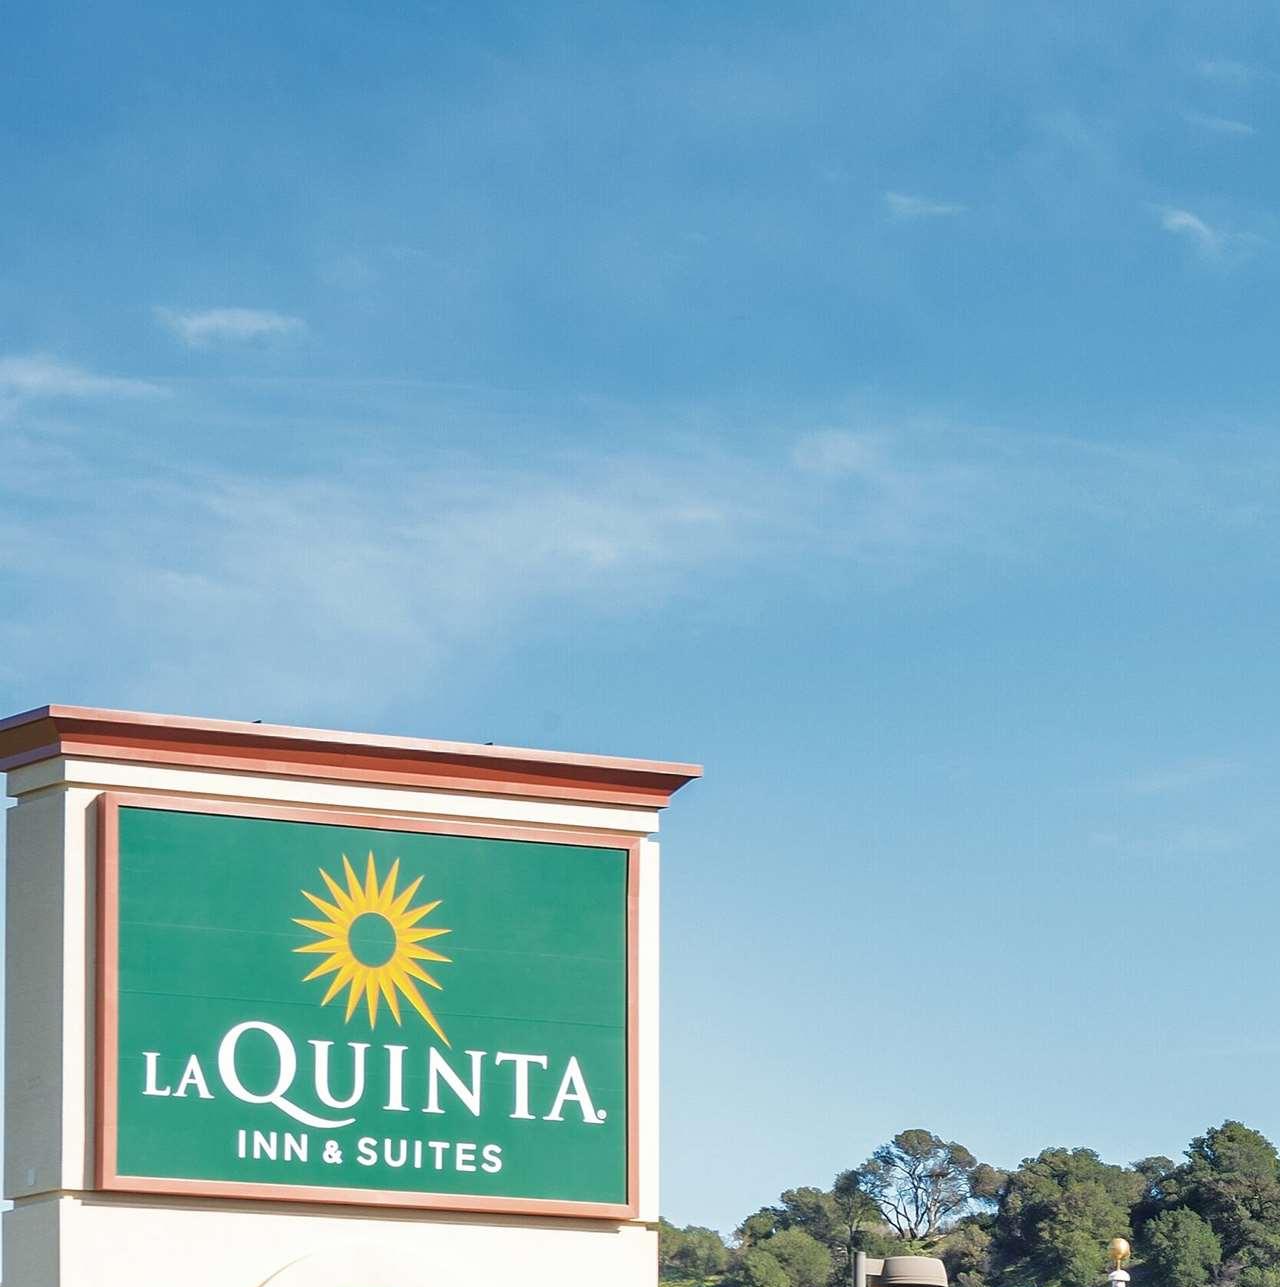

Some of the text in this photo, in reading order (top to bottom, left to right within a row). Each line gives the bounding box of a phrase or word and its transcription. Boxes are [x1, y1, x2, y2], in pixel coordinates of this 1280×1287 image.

[143, 1020, 607, 1128] LA QUINTA
[238, 1129, 504, 1174] INN & SUITES
